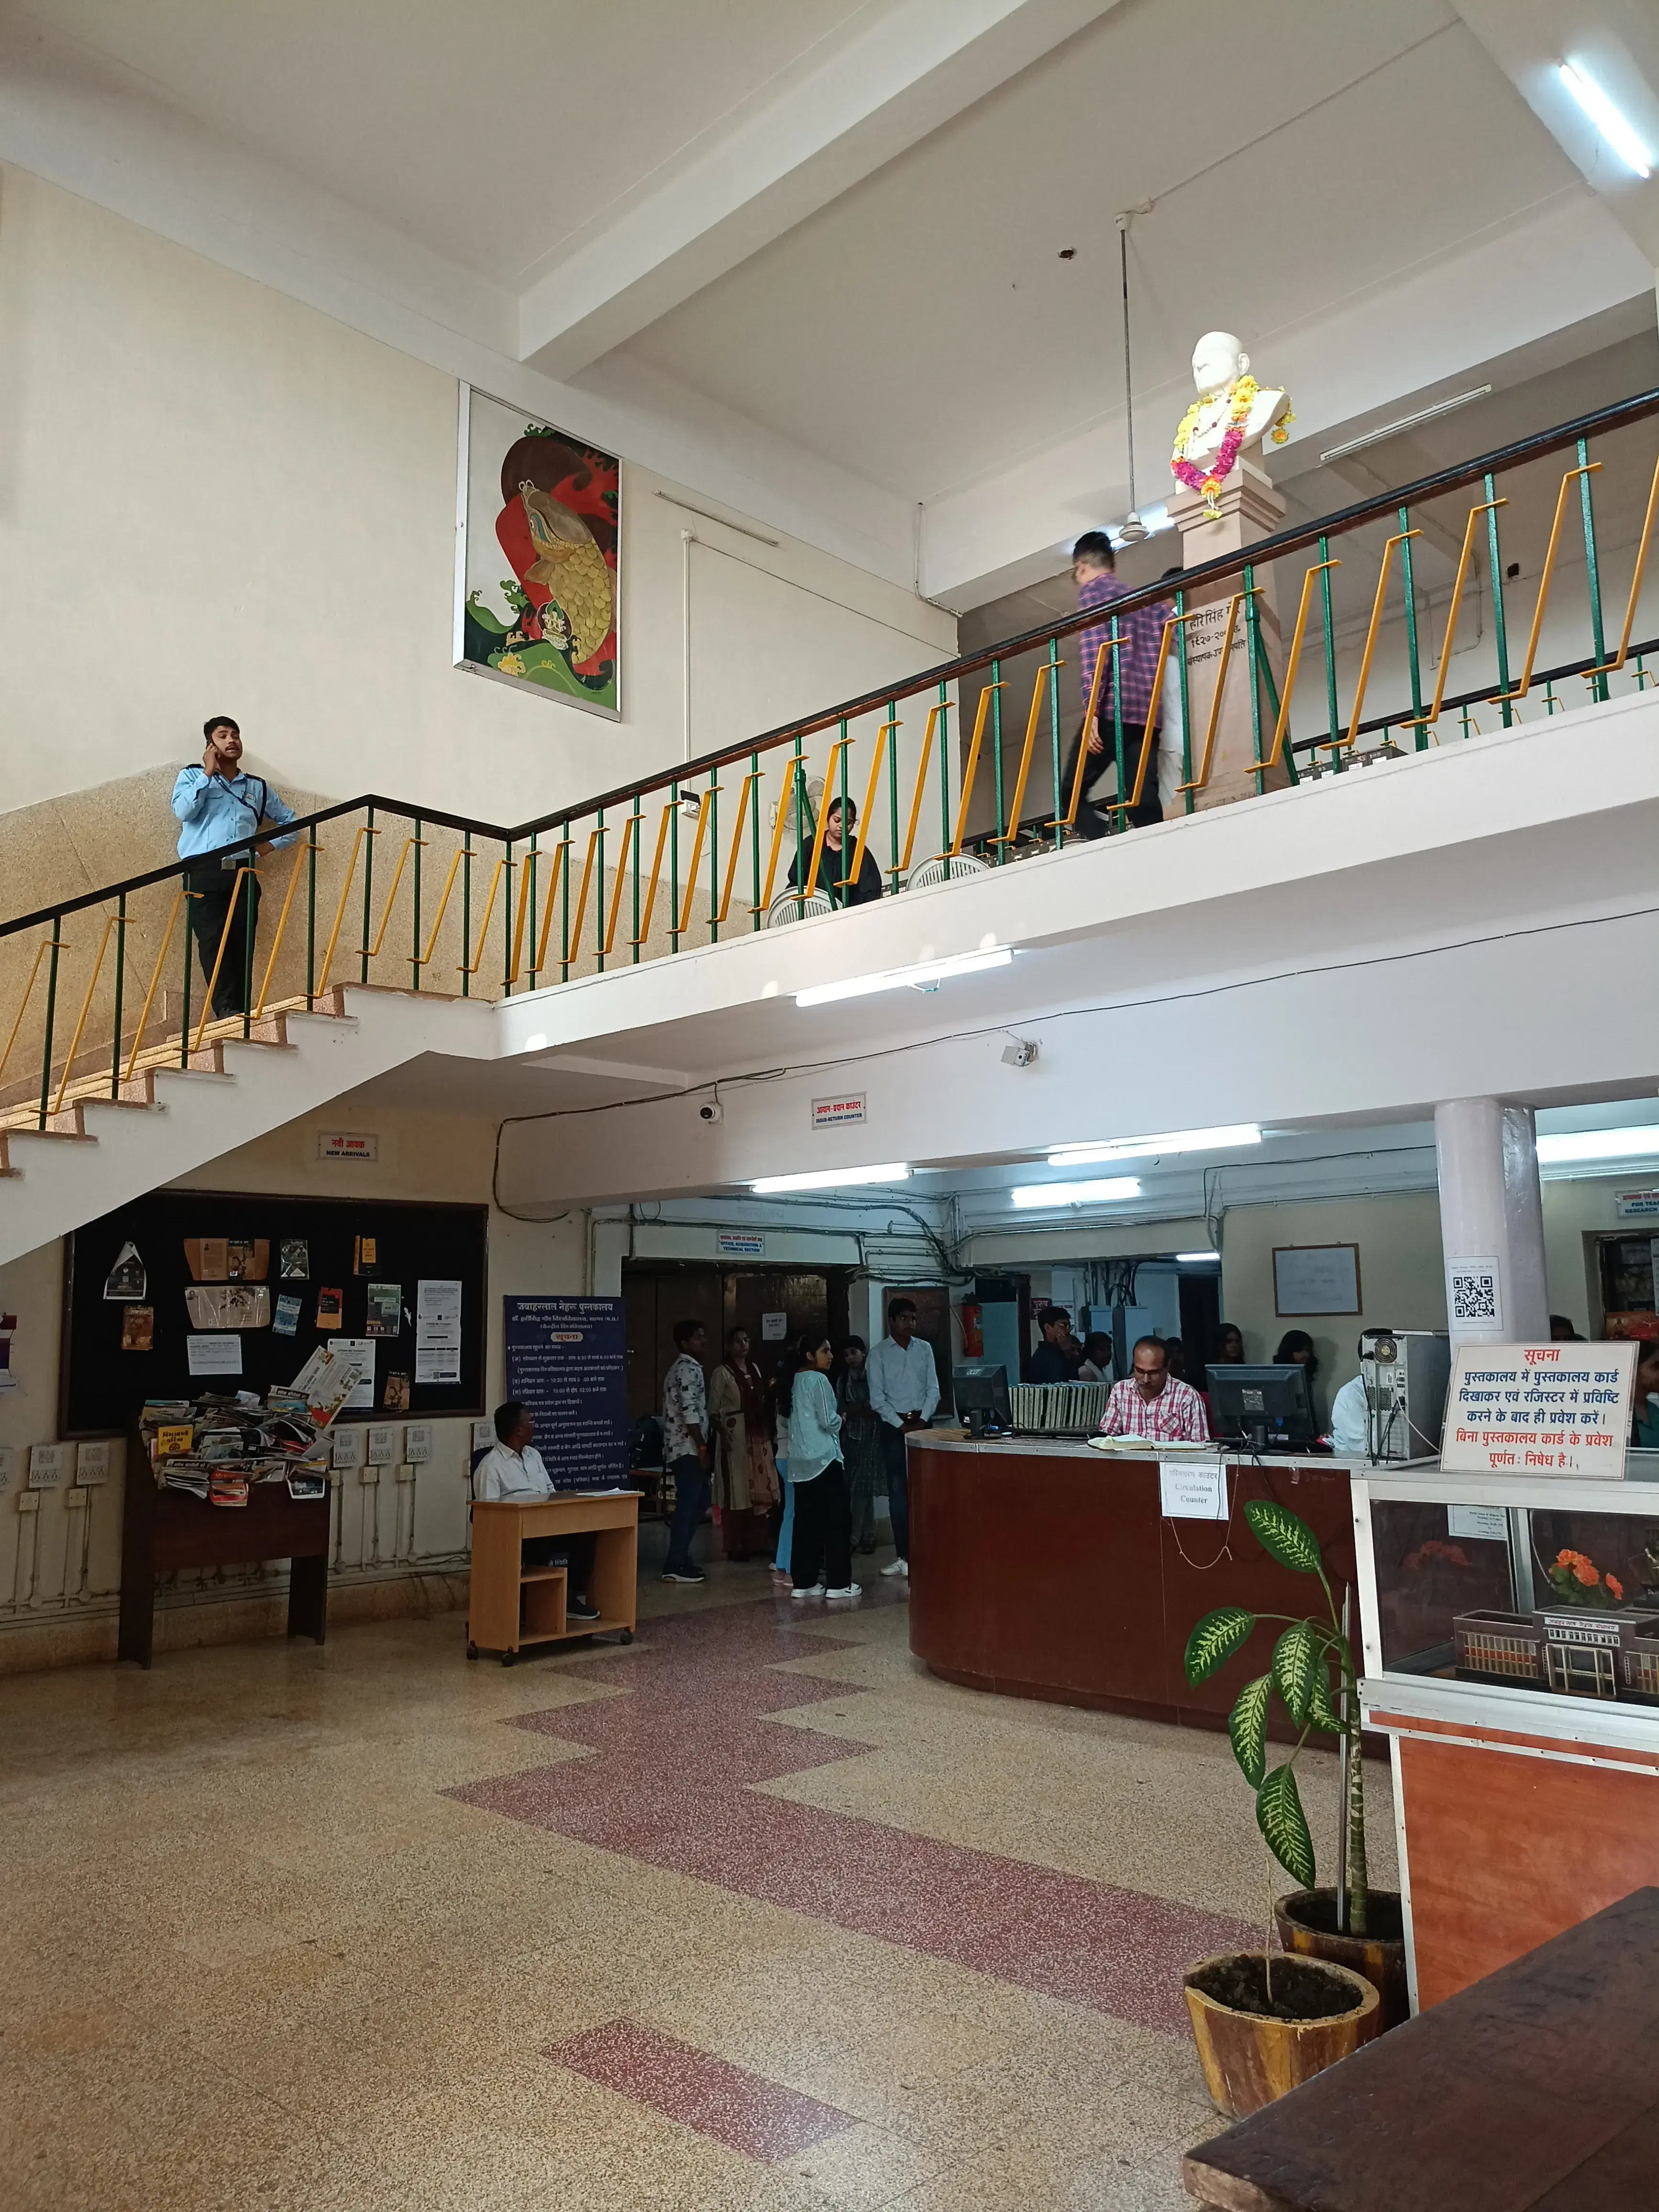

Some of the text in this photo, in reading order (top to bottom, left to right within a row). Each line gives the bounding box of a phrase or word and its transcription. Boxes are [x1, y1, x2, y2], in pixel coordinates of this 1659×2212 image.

[517, 1303, 557, 1312] जवाहरलाल
[1525, 1349, 1560, 1365] सूचना
[1464, 1369, 1619, 1386] पुस्तकालय में पुस्तकालय कार्ड
[1459, 1388, 1620, 1404] दिखाकर एवं रजिस्टर में प्रविष्टि
[1467, 1408, 1492, 1422] करने
[1495, 1408, 1507, 1422] के
[1511, 1411, 1530, 1423] बाद
[1534, 1408, 1546, 1424] ही
[1549, 1409, 1577, 1424] प्रवेश
[1456, 1427, 1614, 1447] बिना पुस्तकालय कार्ड के प्रवेश
[1525, 1450, 1554, 1467] निषेध
[1198, 1471, 1217, 1480] काउंटर
[1175, 1483, 1213, 1493] Circulation
[1181, 1495, 1208, 1504] Counter
